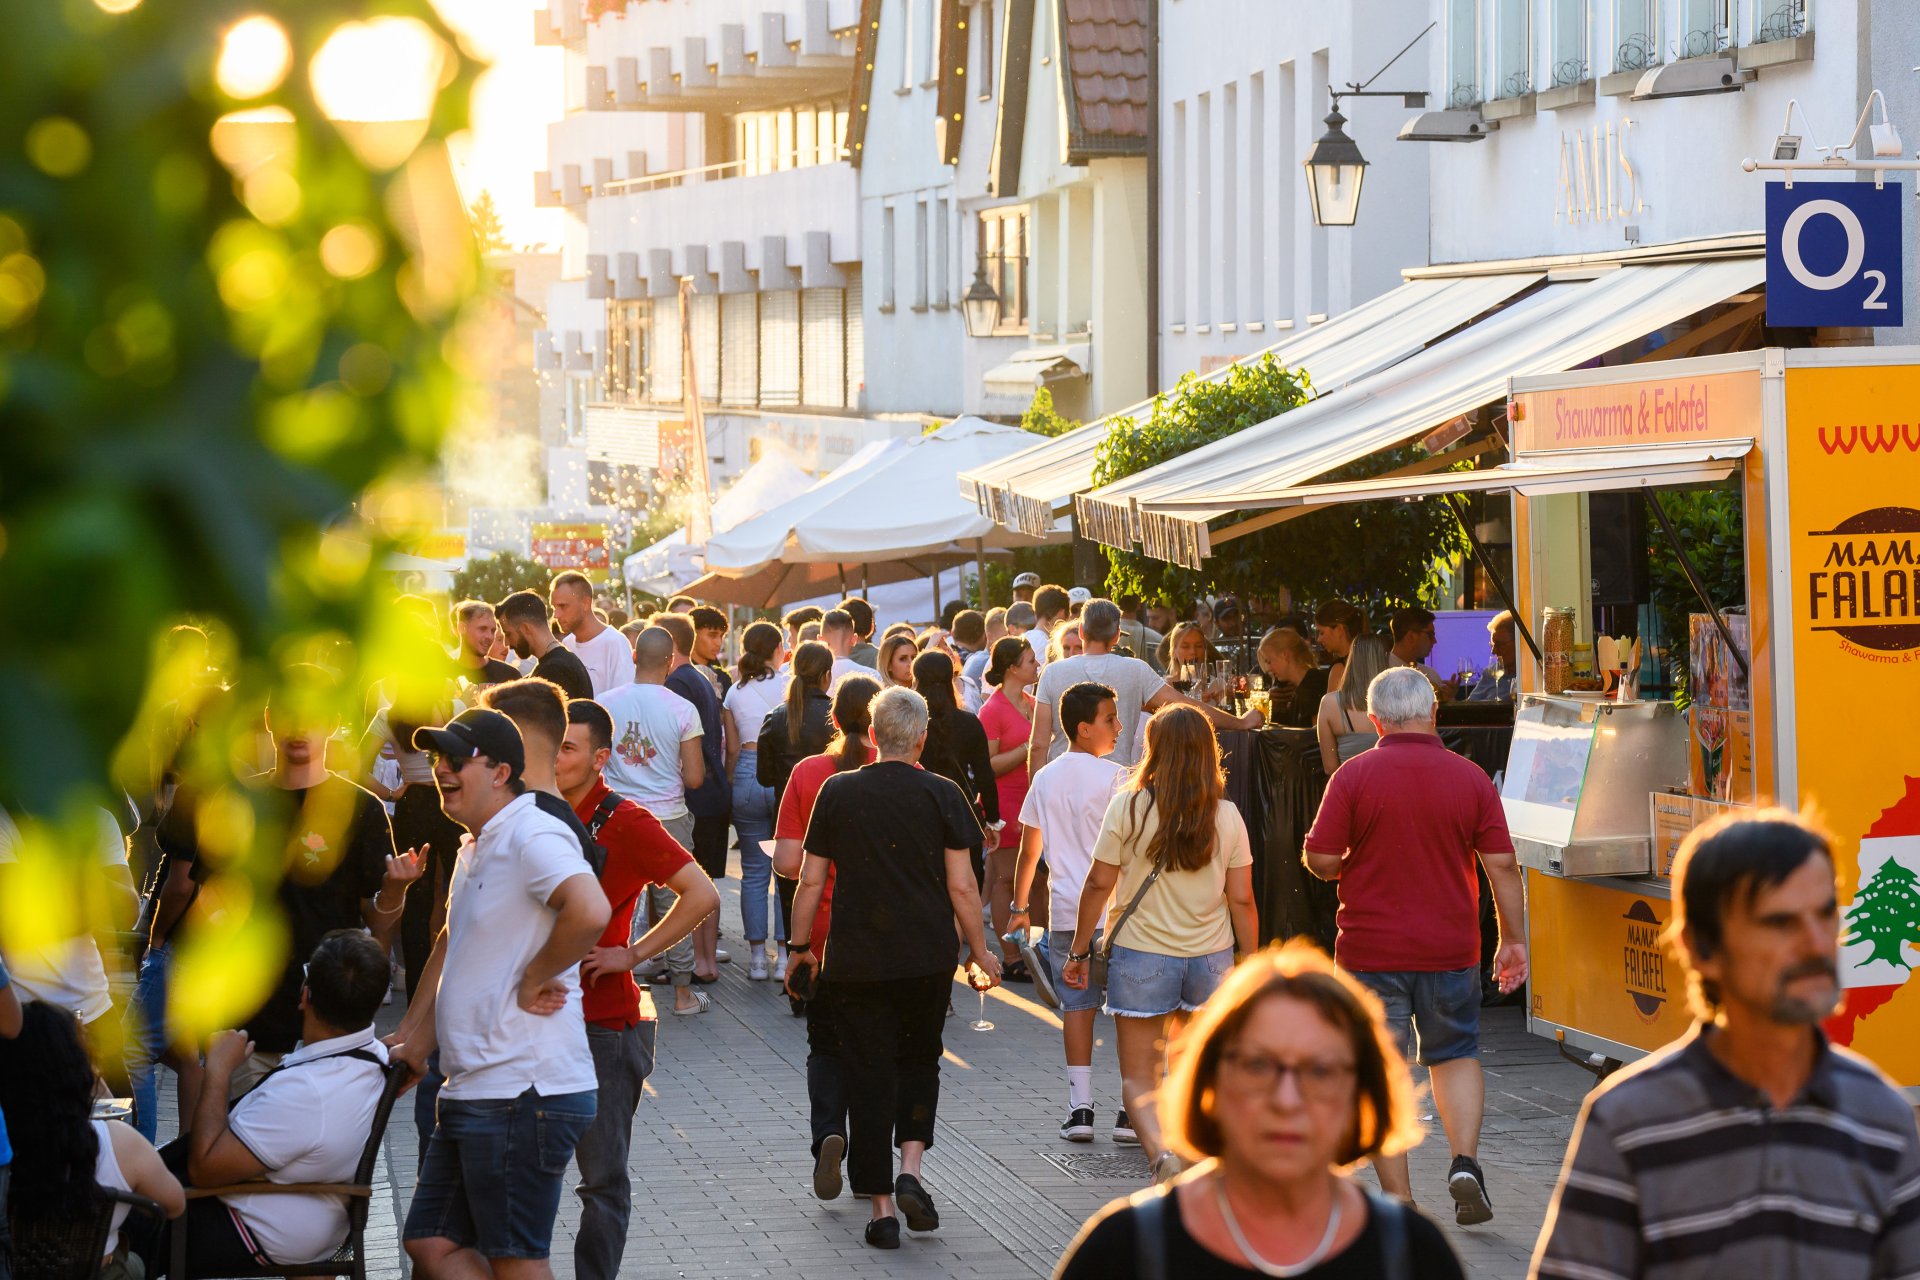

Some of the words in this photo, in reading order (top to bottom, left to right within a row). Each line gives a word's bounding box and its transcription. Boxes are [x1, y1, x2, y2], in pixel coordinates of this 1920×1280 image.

[1555, 396, 1633, 441] Shawarma
[1637, 389, 1650, 435] &
[1654, 383, 1709, 433] Falafel
[1823, 539, 1920, 568] MAM
[1838, 639, 1899, 665] Shawarma
[1902, 652, 1913, 664] &
[1626, 923, 1660, 951] MAMA'S
[1623, 945, 1667, 994] FALAFEL
